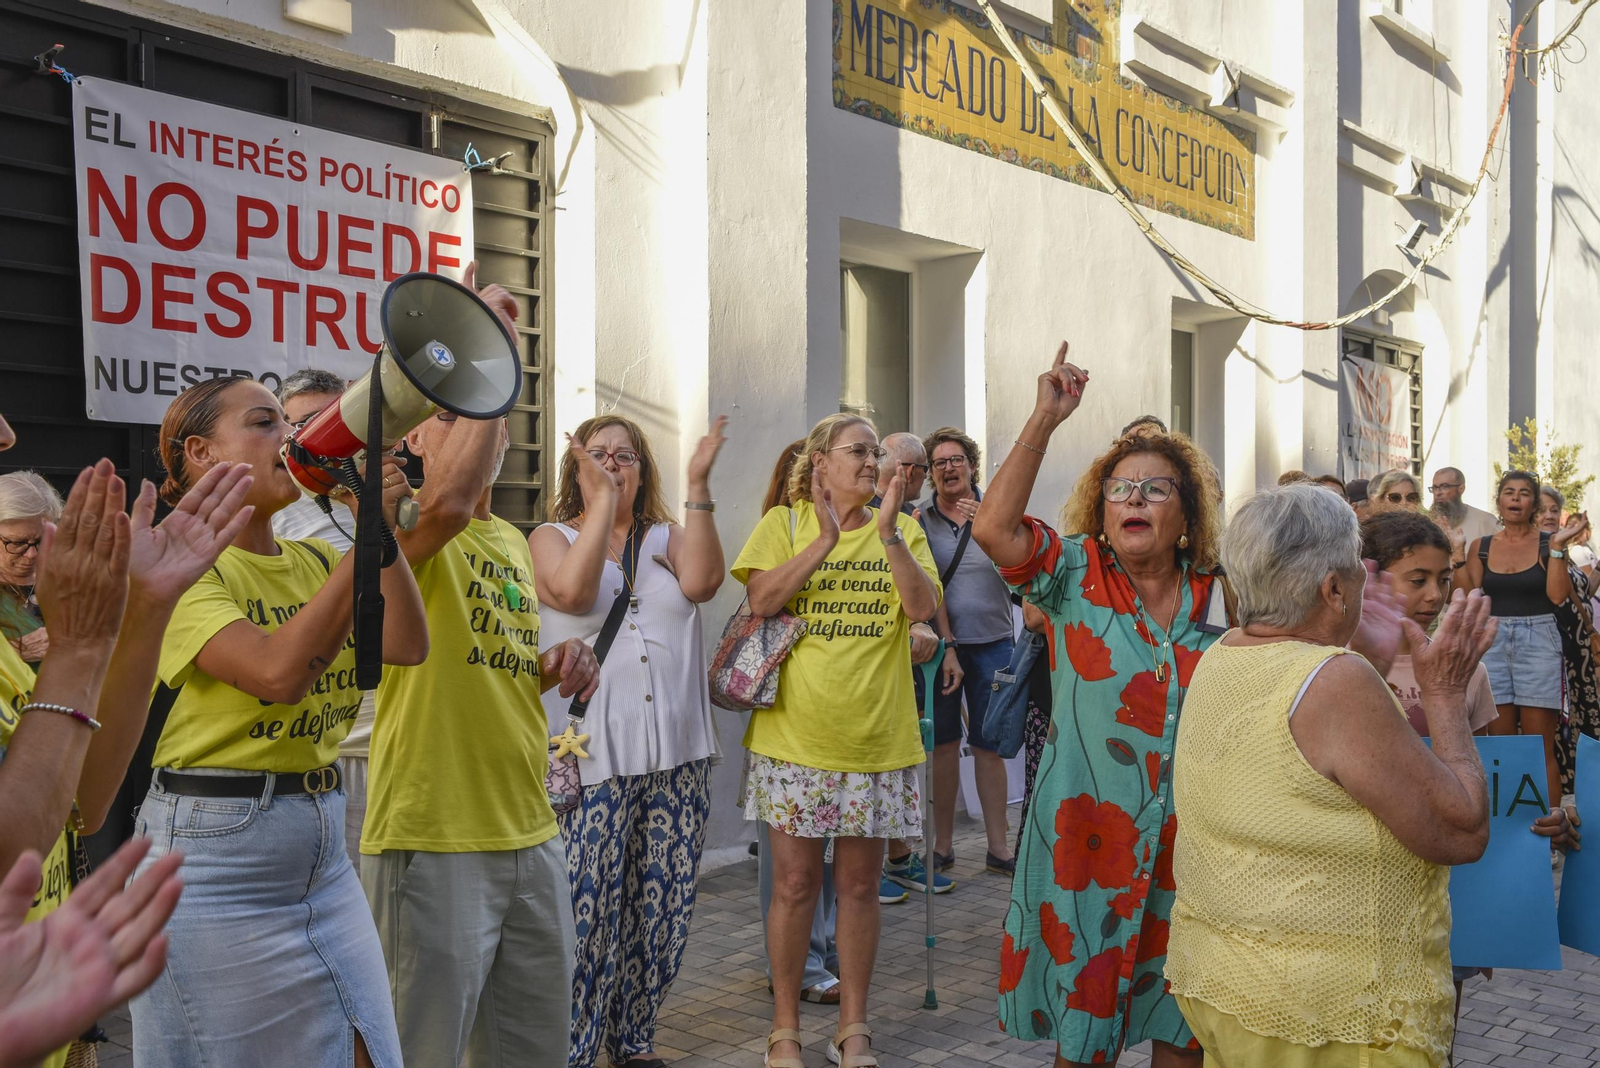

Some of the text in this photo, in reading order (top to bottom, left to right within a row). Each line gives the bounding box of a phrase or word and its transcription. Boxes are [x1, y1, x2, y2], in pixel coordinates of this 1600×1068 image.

[850, 1, 1248, 212] MERCADO DE LA CONCEPCION
[85, 106, 461, 213] EL INTERÉS POLÍTICO
[87, 167, 462, 282] NO PUEDE
[90, 253, 385, 354] DESTRU
[94, 355, 282, 398] NUESO
[1356, 366, 1392, 426] NO
[795, 597, 891, 615] El mercado
[818, 579, 837, 591] se
[841, 578, 892, 593] vende
[470, 607, 492, 634] El
[249, 696, 364, 745] se defiend
[1492, 759, 1549, 817] iA
